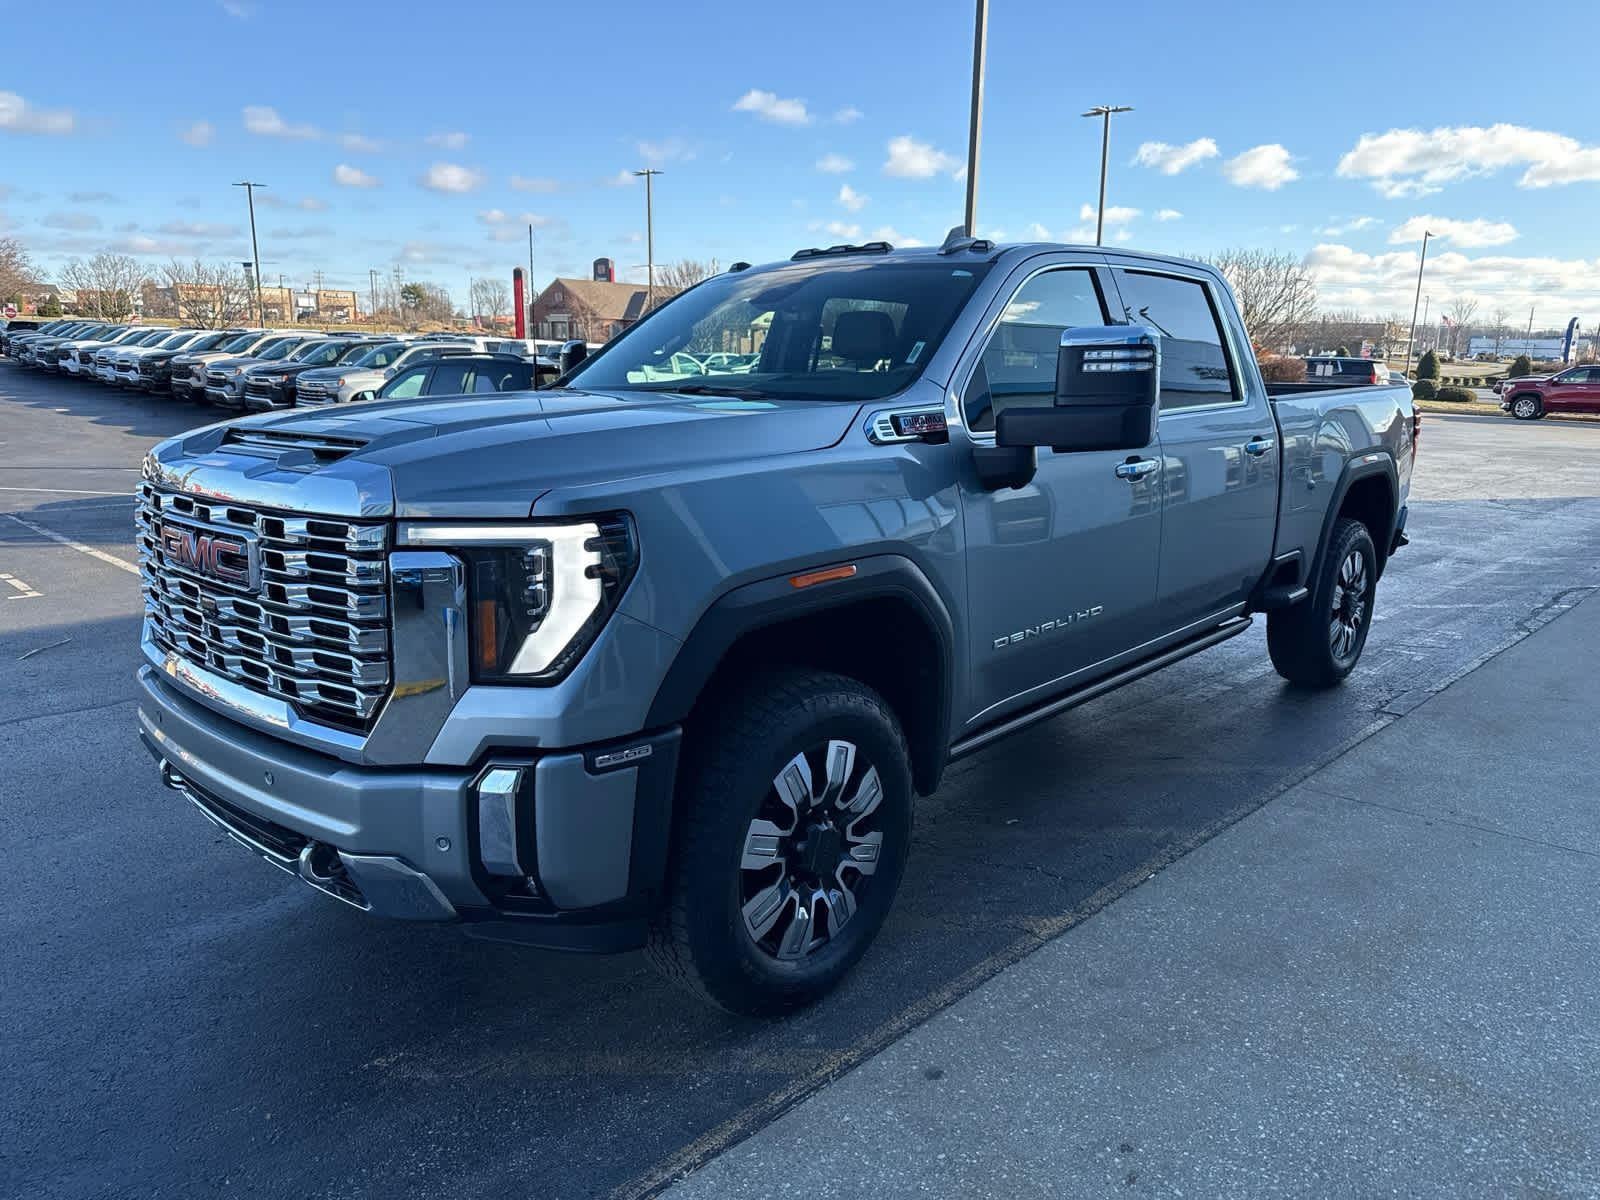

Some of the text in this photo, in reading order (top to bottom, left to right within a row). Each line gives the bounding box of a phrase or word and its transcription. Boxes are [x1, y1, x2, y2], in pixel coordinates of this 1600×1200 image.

[160, 526, 242, 578] GMC
[993, 606, 1104, 648] DENALI HD
